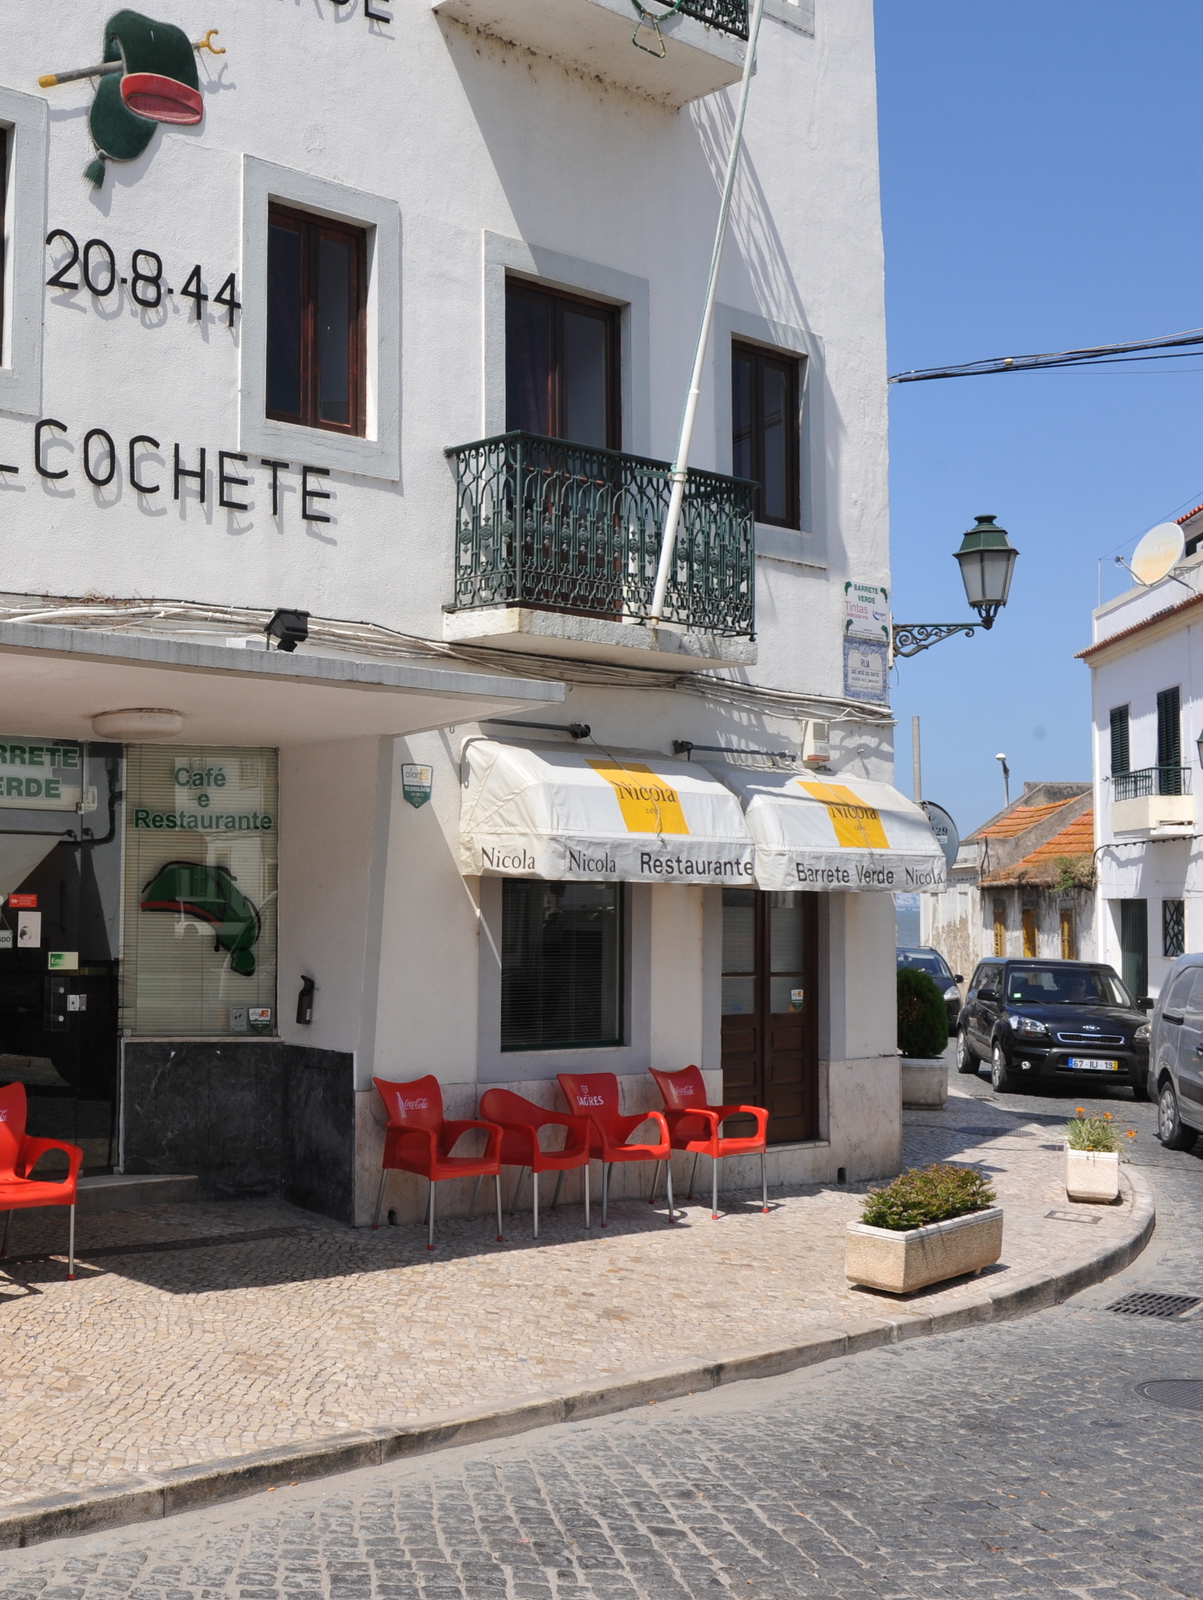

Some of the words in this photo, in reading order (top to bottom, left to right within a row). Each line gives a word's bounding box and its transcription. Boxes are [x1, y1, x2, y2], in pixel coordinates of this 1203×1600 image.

[854, 584, 878, 594] BARRETE
[844, 601, 868, 614] Tintas
[858, 595, 875, 604] VERDE
[860, 658, 870, 668] RUA
[174, 767, 226, 788] Café
[610, 780, 677, 802] Nicola
[197, 793, 210, 808] e
[827, 802, 878, 820] Nicola
[134, 808, 273, 831] Restaurante
[480, 846, 536, 870] Nicola
[569, 850, 616, 873] Nicola
[640, 852, 754, 876] Restaurante
[796, 862, 850, 883] Barrete
[855, 865, 894, 884] Verde
[905, 867, 944, 885] Nicola
[405, 1098, 428, 1110] Coca-Cola
[577, 1096, 604, 1107] SAGRES
